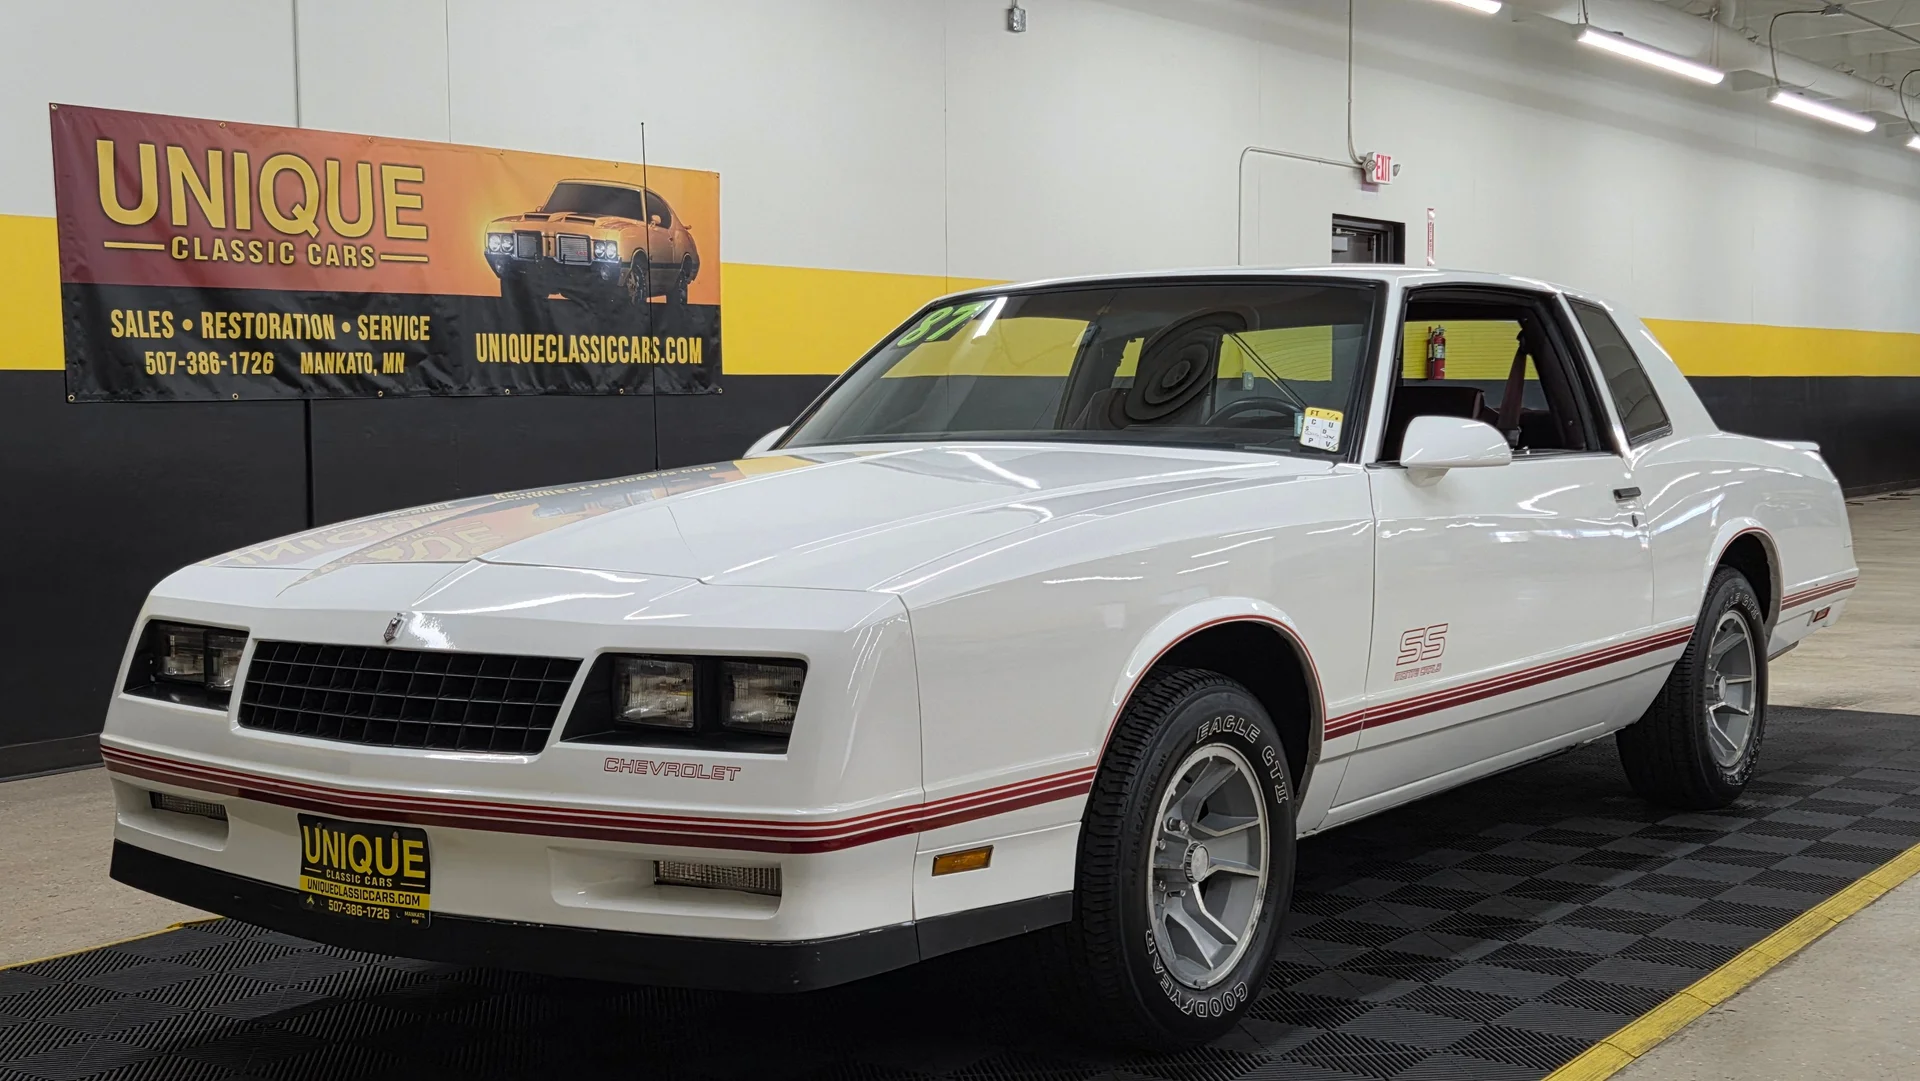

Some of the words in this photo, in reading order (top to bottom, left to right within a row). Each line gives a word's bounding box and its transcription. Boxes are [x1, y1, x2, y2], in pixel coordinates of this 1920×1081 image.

[1375, 153, 1392, 182] EXIT
[96, 139, 428, 240] UNIQUE
[171, 235, 295, 265] CLASSIC
[308, 243, 376, 268] CARS
[111, 309, 174, 339] SALES
[201, 311, 335, 340] RESTORATION
[358, 315, 430, 341] SERVICE
[897, 301, 985, 348] 87
[145, 350, 274, 375] 507-386-1726
[301, 351, 378, 377] MANKATO,
[383, 352, 405, 374] MN
[475, 332, 702, 364] UNIQUECLASSICCARS.COM
[1396, 623, 1448, 666] SS
[1196, 714, 1261, 744] EAGLE
[603, 757, 742, 782] CHEVROLET
[303, 825, 426, 879] UNIQUE
[307, 878, 420, 907] UNIQUECLASSICCARS.COM
[326, 869, 361, 884] CLASSIC
[364, 876, 393, 888] CARS
[328, 900, 390, 920] 507-386-1726
[1145, 929, 1248, 1018] GOODYEAR
